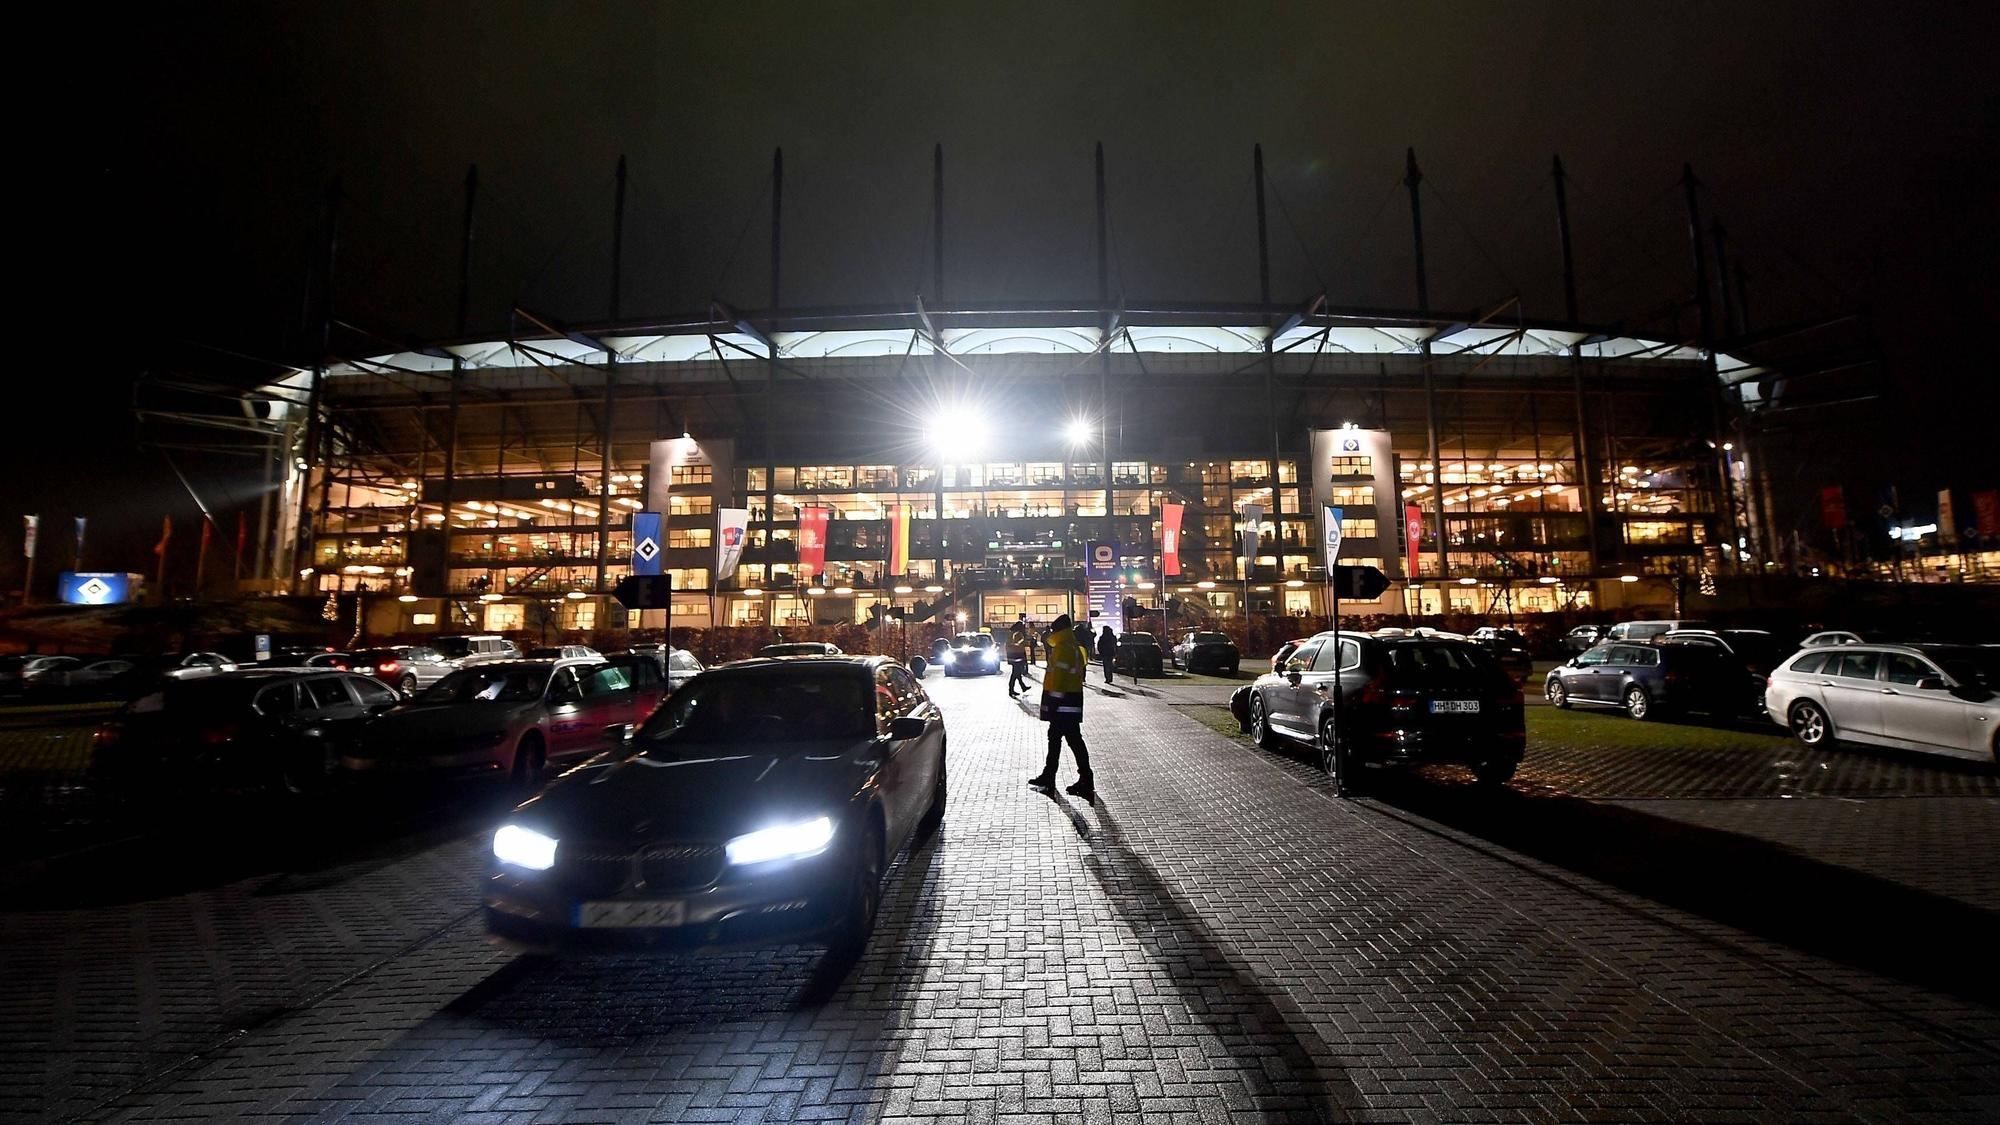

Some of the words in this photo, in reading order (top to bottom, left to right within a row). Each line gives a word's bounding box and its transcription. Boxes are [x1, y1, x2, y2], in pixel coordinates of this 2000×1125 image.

[638, 577, 652, 606] E
[1352, 569, 1365, 597] F
[1434, 702, 1445, 711] HH
[1463, 702, 1479, 711] 303
